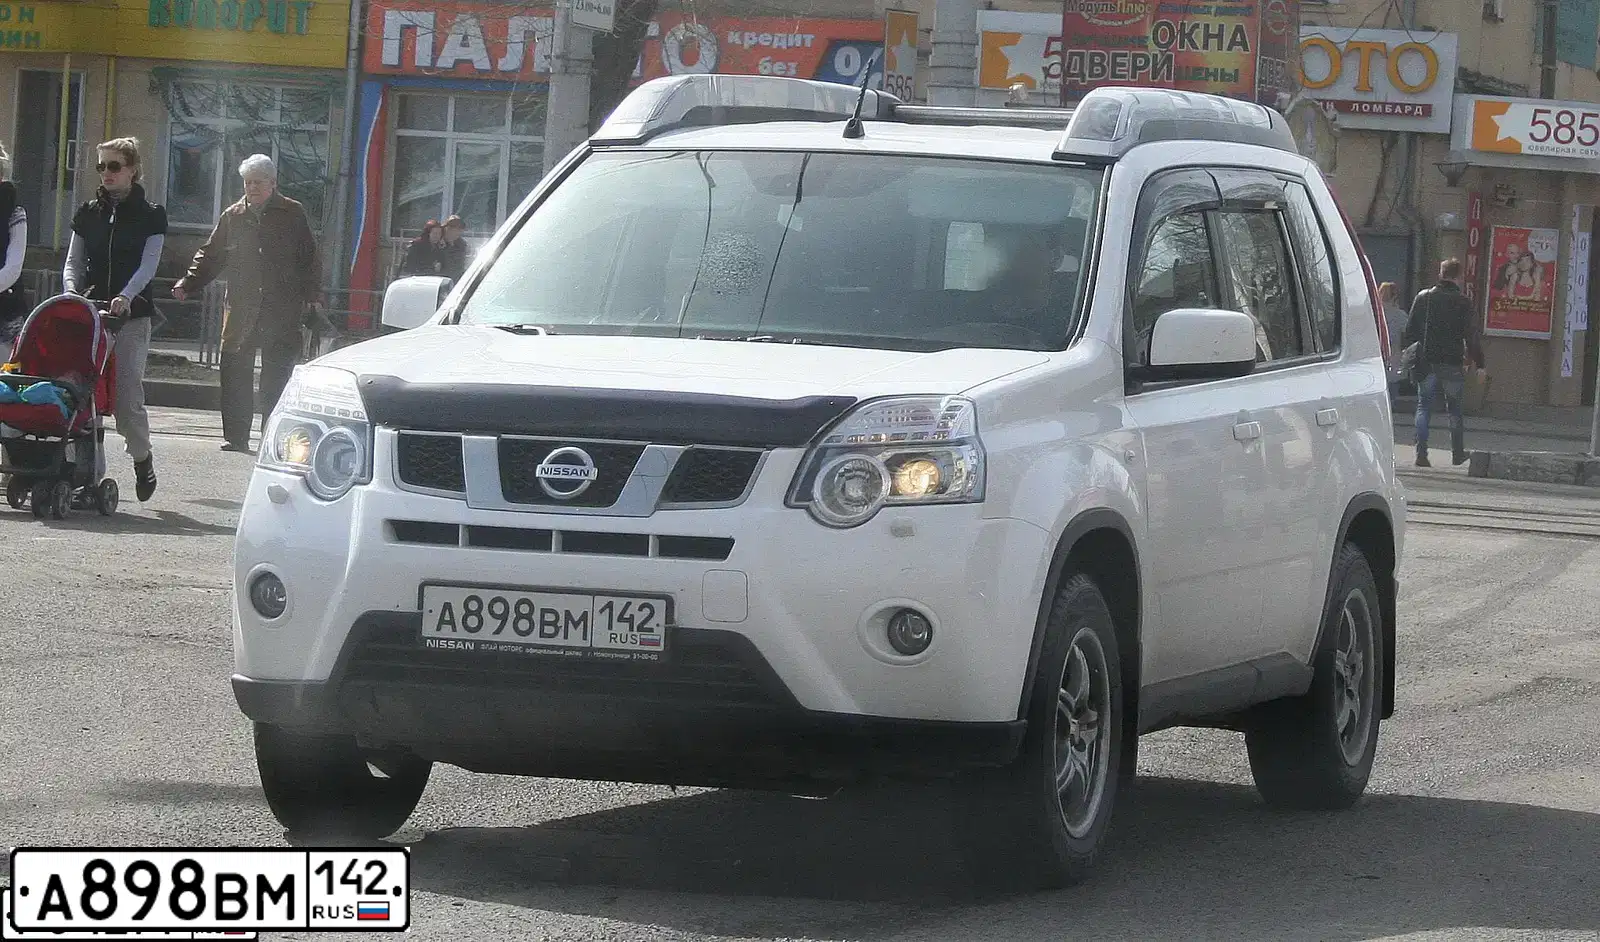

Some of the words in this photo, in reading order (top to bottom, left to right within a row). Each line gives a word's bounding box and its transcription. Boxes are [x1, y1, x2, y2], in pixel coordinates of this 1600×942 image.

[727, 30, 816, 48] кредит
[1151, 20, 1250, 52] ОКНА
[758, 56, 798, 76] без
[1065, 50, 1175, 84] ДВЕРИ
[886, 74, 913, 102] 585
[1351, 103, 1423, 116] ЛОМБАРД
[1529, 109, 1599, 146] 585
[540, 467, 590, 477] NISSAN
[436, 594, 588, 641] А898ВМ
[598, 600, 656, 632] 142
[426, 639, 475, 650] NISSAN
[609, 632, 638, 645] RUS
